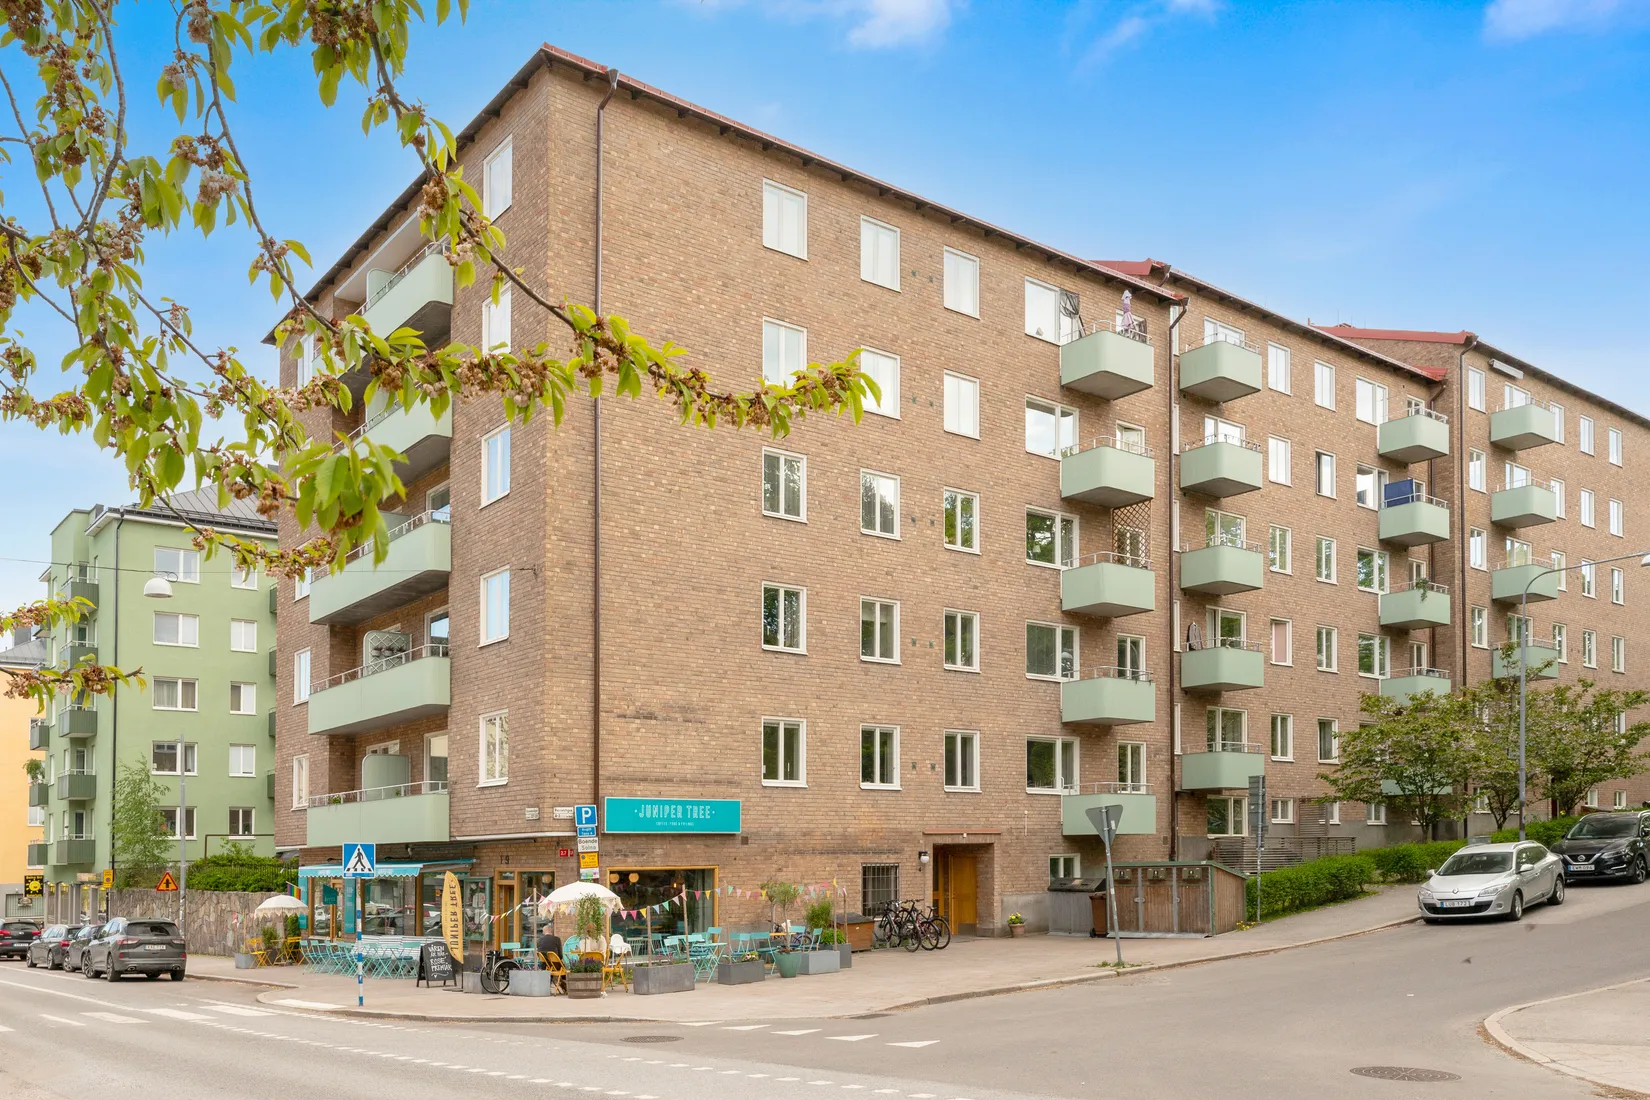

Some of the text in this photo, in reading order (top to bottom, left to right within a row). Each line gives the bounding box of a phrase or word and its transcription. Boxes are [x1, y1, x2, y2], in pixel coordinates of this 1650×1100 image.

[582, 808, 592, 824] P
[638, 804, 711, 819] JUNIPER TREE
